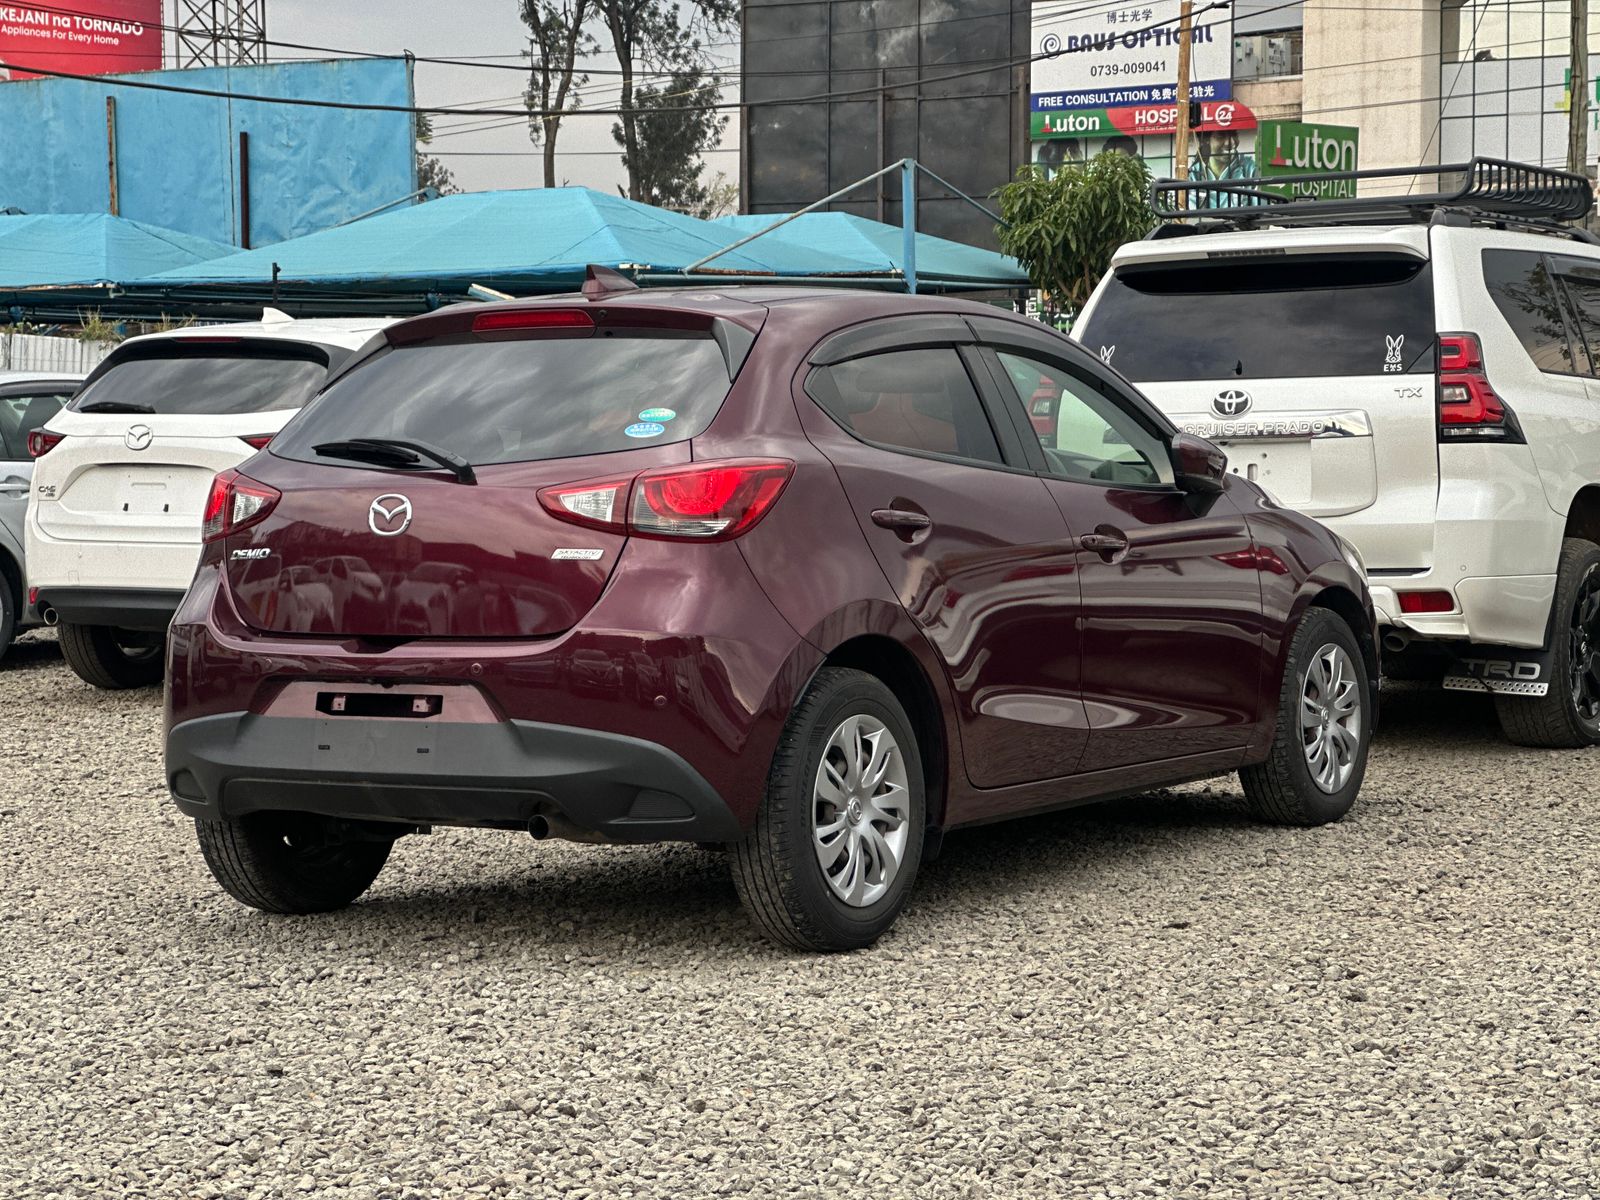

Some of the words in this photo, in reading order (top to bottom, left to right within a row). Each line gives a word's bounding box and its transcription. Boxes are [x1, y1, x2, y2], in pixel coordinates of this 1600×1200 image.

[0, 7, 49, 25] KEJANI
[52, 15, 71, 28] na
[73, 16, 144, 36] TORNADO
[1107, 8, 1153, 24] 博士光学
[1, 24, 51, 38] Appliances
[52, 29, 67, 39] For
[68, 31, 92, 44] Every
[93, 34, 119, 45] Home
[1090, 60, 1166, 77] 0739-009041
[1038, 96, 1063, 107] FREE
[1065, 90, 1148, 105] CONSULTATION
[1041, 114, 1100, 133] Luton
[1135, 107, 1213, 125] HOSPL
[1219, 110, 1232, 120] 24
[1270, 125, 1356, 171] Luton
[1292, 179, 1354, 198] HOSPITAL
[1383, 363, 1403, 372] EMS
[1394, 387, 1422, 398] TX
[1184, 422, 1259, 438] CRUISER
[1262, 420, 1326, 435] PRADO
[230, 548, 271, 560] DEMIO
[1460, 658, 1541, 680] TRD
